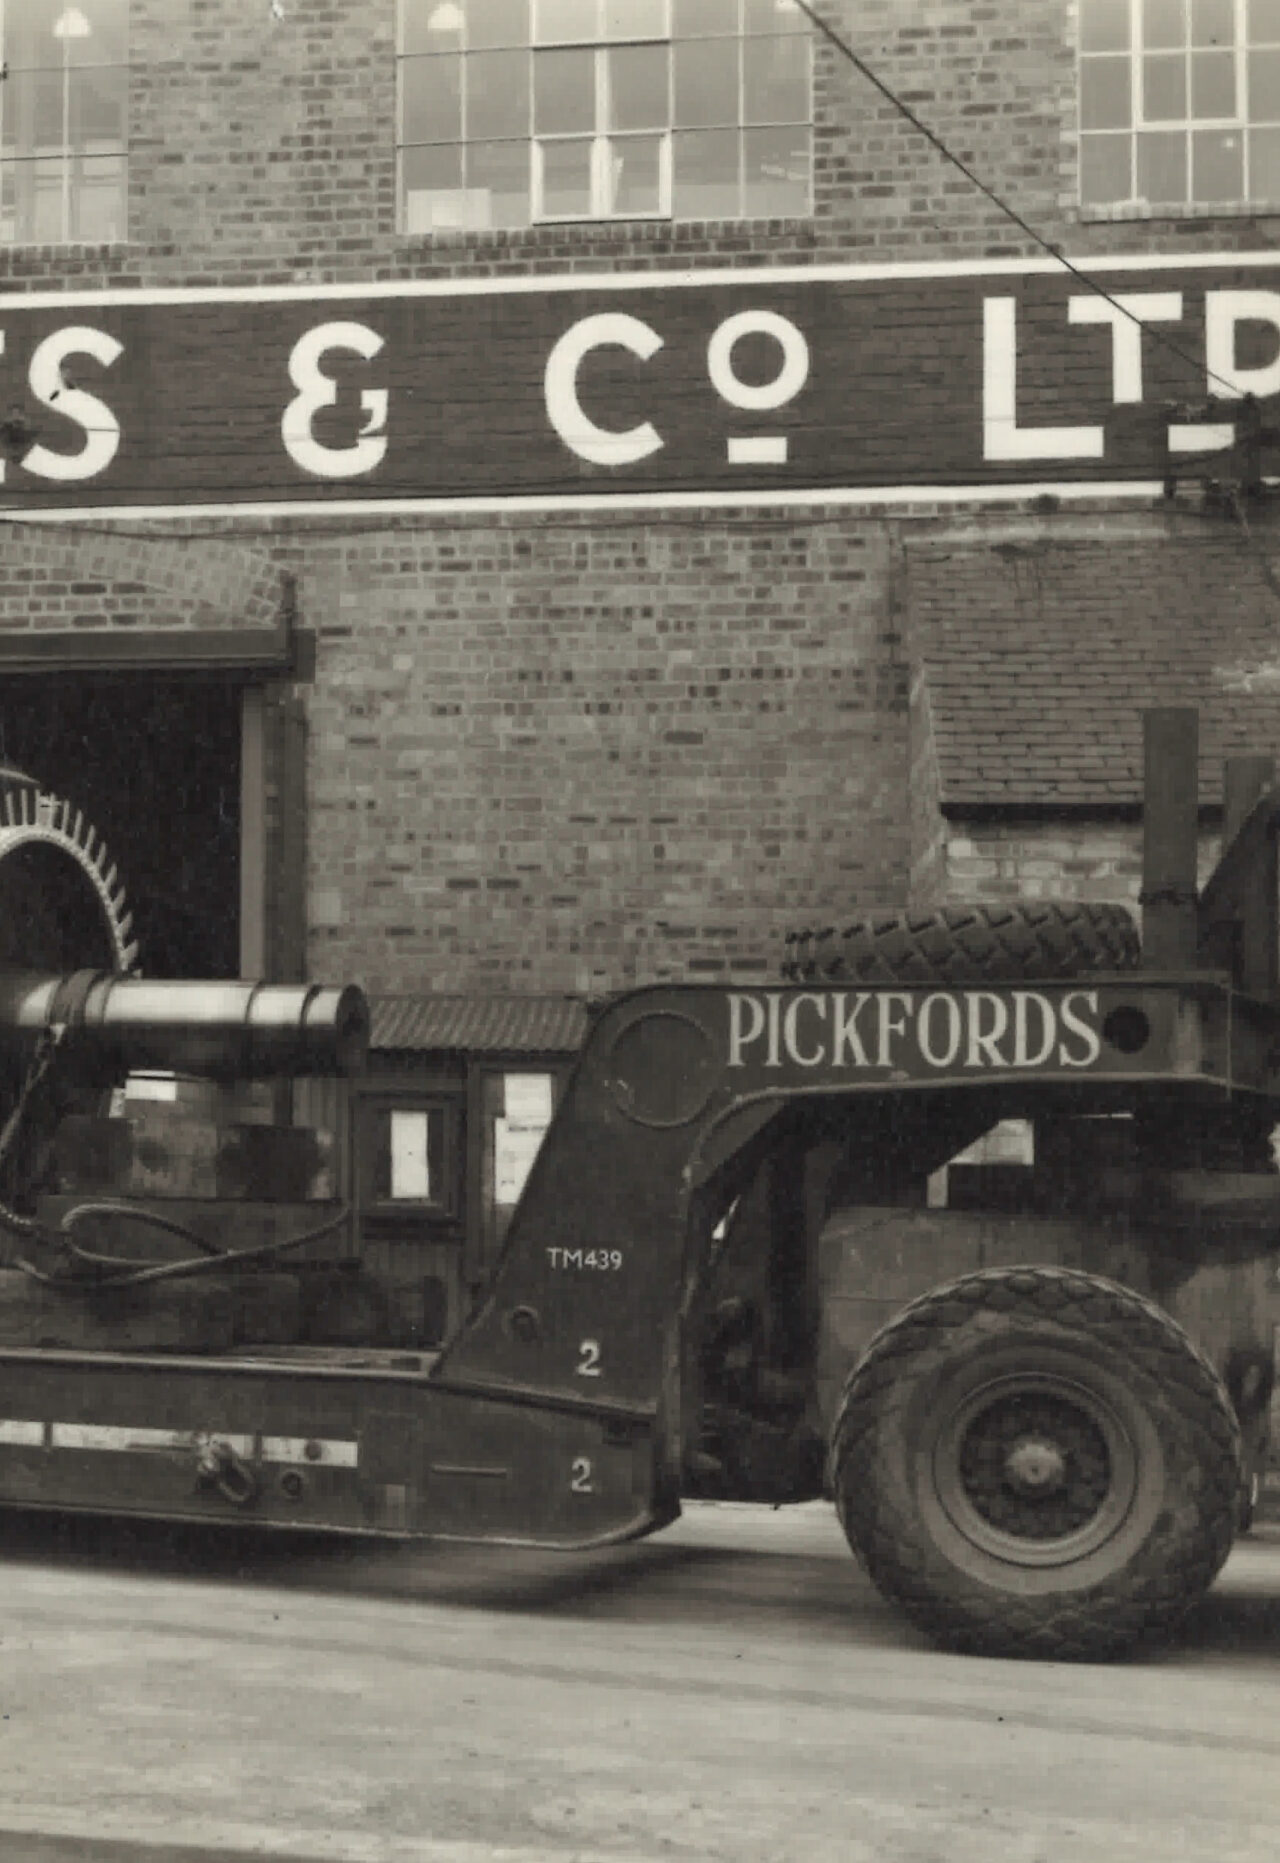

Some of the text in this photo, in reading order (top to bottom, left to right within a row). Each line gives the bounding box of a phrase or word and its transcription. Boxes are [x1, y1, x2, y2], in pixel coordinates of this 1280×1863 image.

[281, 320, 389, 478] &
[982, 289, 1280, 461] LTD
[726, 991, 1102, 1068] PICKFORDS
[546, 1247, 623, 1271] TM439
[575, 1338, 602, 1377] 2
[570, 1456, 594, 1493] 2
